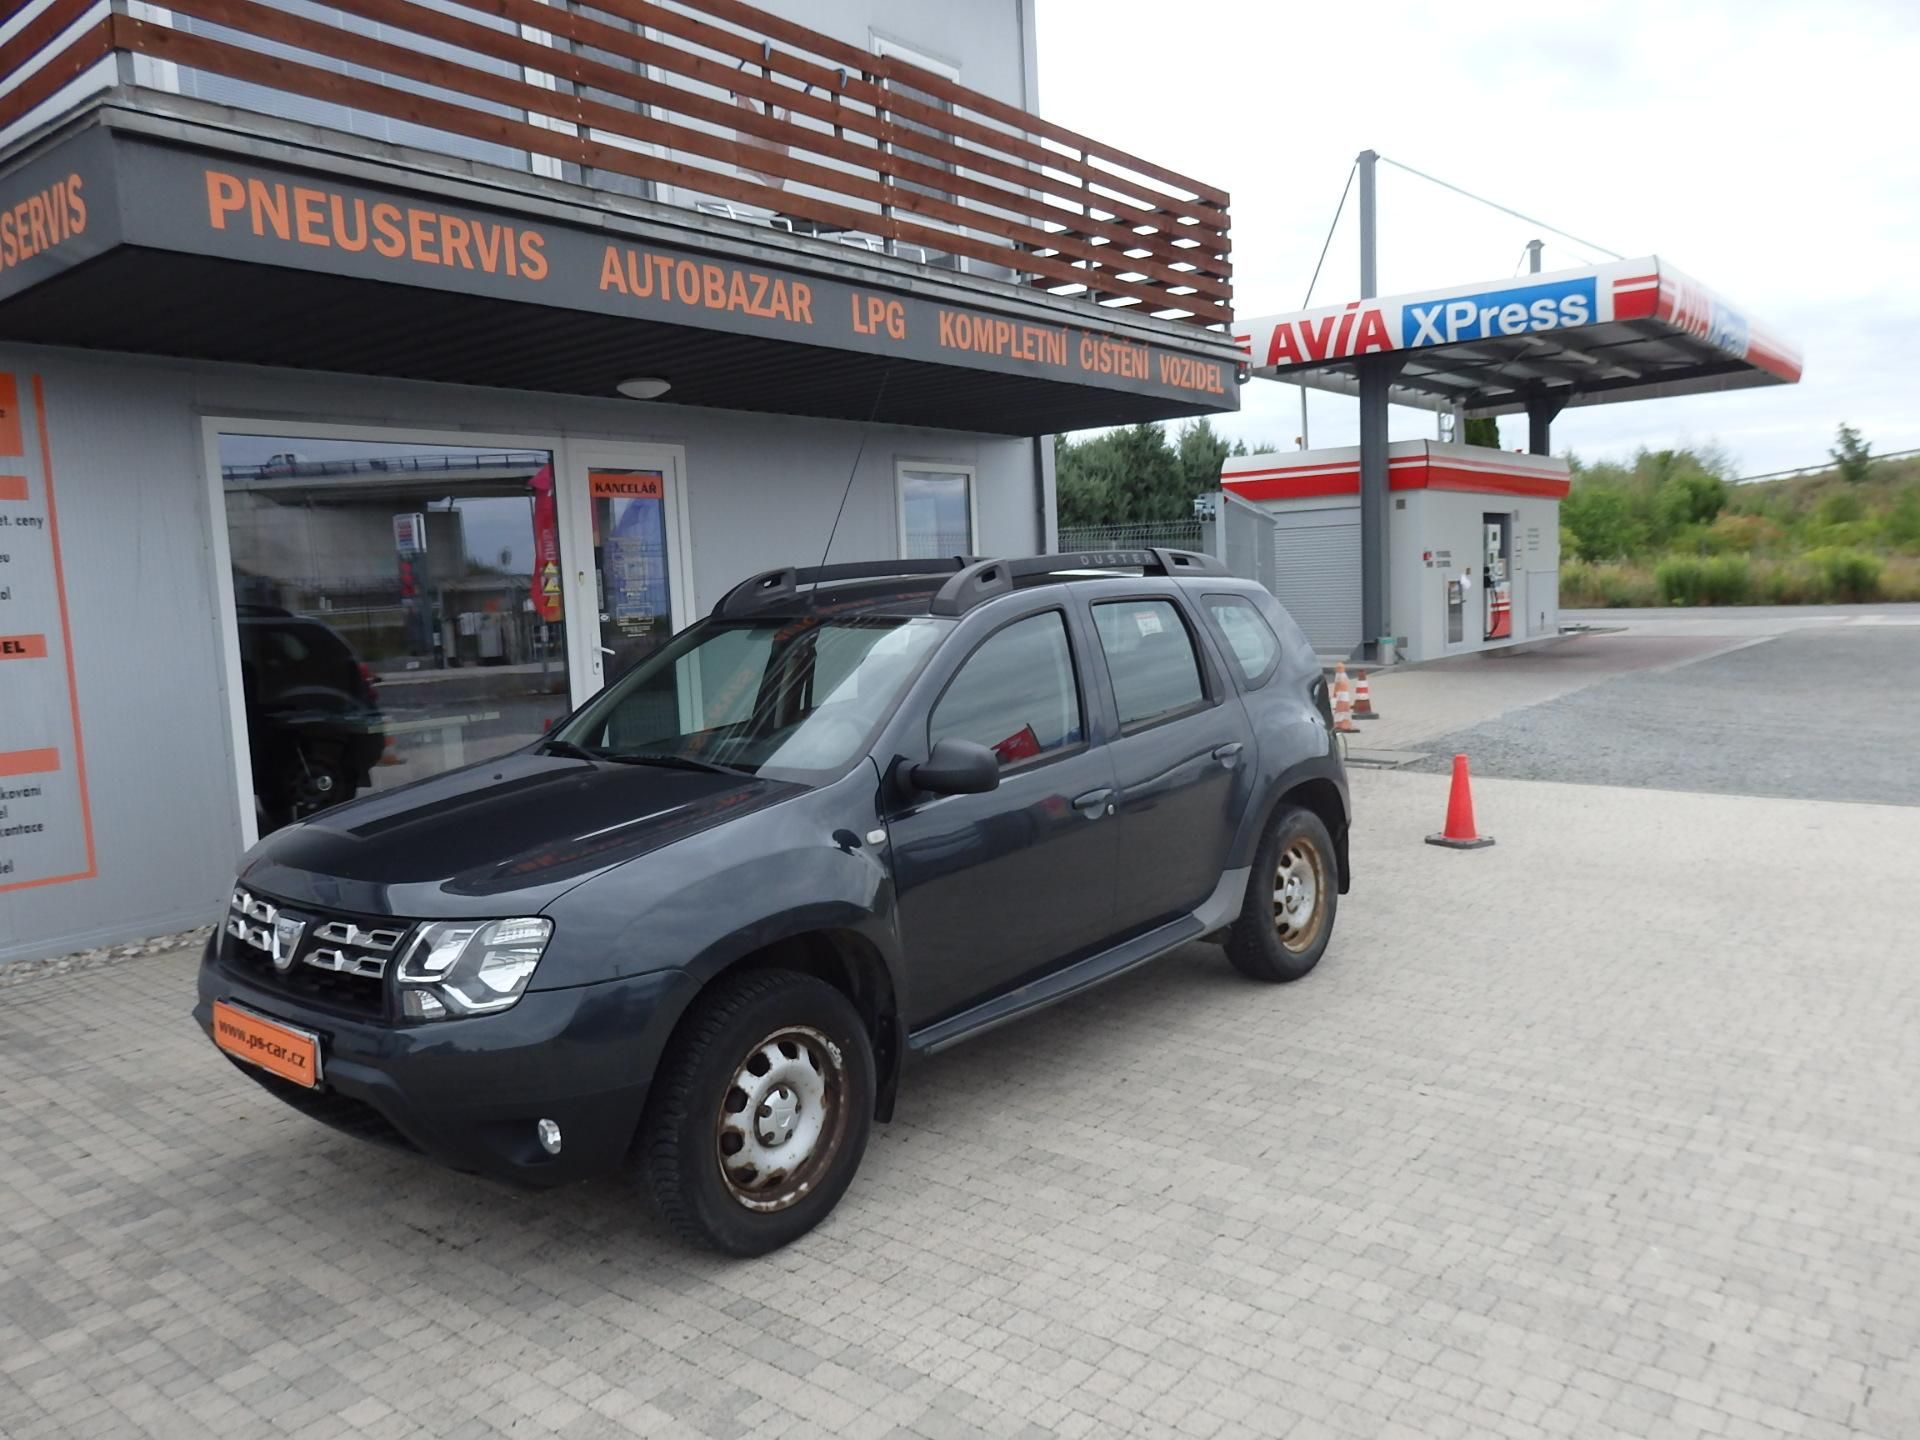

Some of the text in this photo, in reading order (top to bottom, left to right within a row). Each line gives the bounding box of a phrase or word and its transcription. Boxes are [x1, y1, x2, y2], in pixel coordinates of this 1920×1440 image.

[0, 173, 87, 273] SERVIS
[205, 170, 549, 281] PNEUSERVIS
[599, 245, 813, 325] AUTOBAZAR
[852, 292, 906, 340] LPG
[1159, 353, 1224, 394] VOZIDEL
[1410, 294, 1589, 348] XPress
[16, 517, 44, 529] ceny
[1079, 554, 1154, 566] DUSTER
[0, 640, 26, 654] EL
[219, 1020, 306, 1068] www.ps-car.cz
